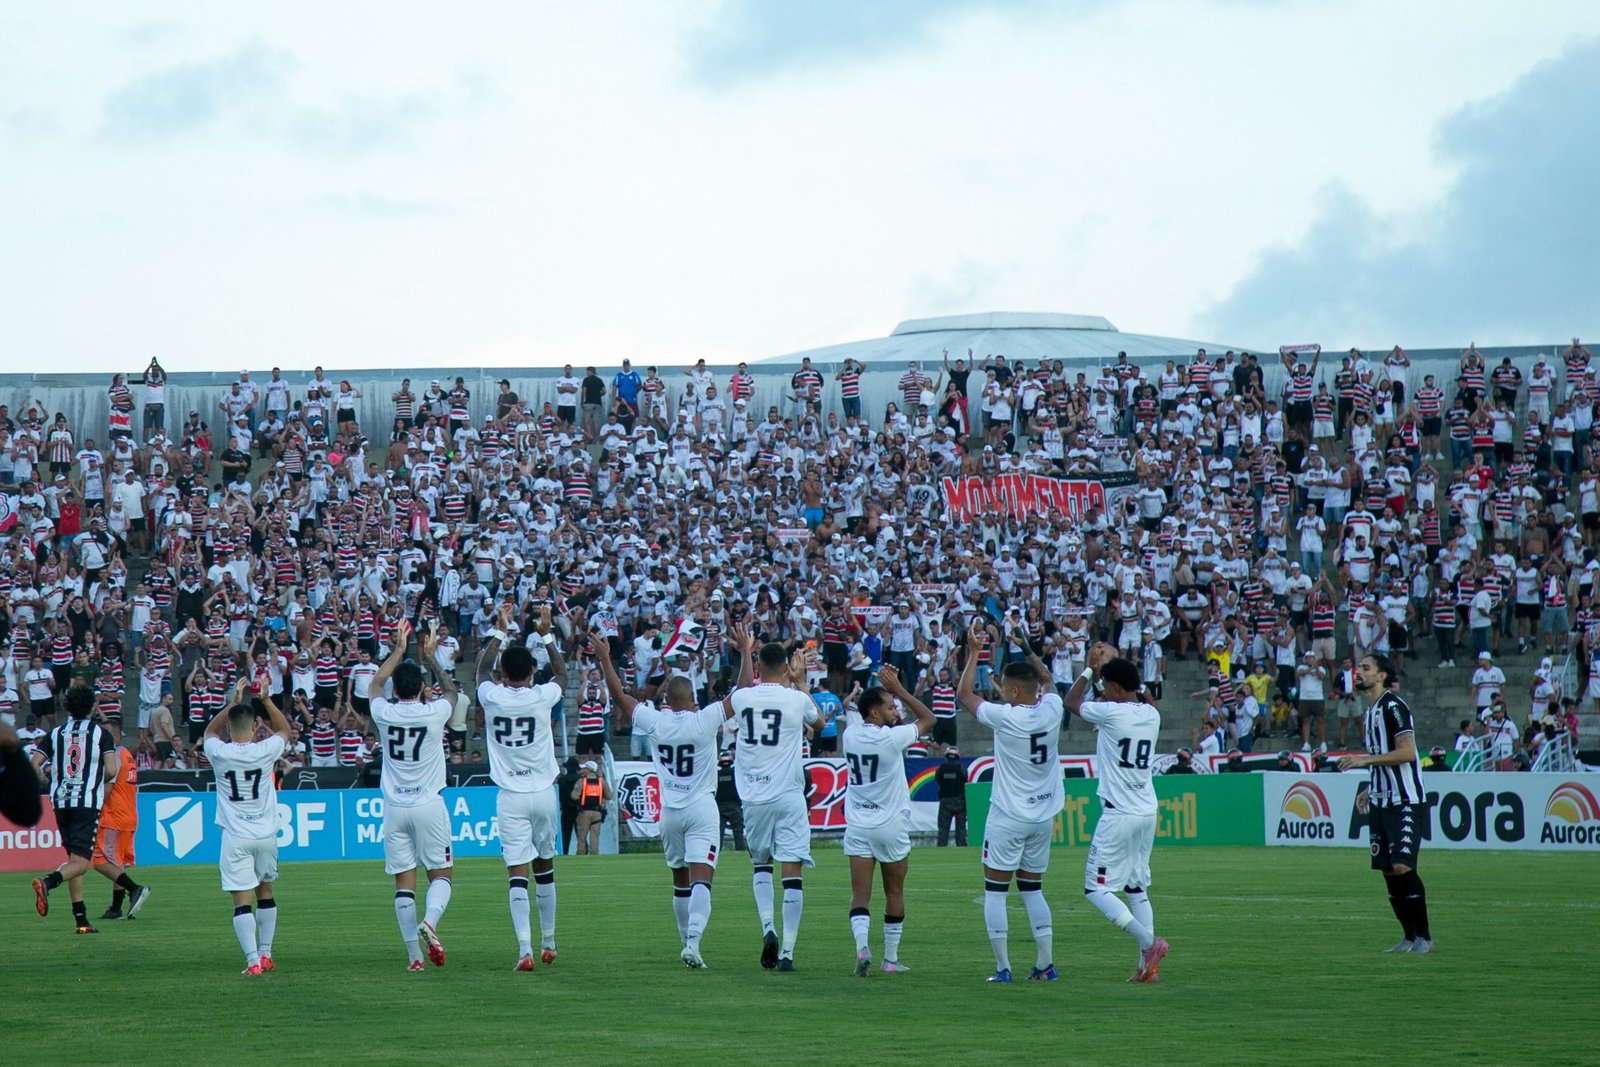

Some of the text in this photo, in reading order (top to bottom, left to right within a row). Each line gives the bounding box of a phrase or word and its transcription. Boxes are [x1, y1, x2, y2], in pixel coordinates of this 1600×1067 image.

[942, 473, 1104, 525] MOVIMENTO
[821, 702, 835, 716] 10
[388, 726, 427, 761] 27
[494, 716, 536, 747] 23
[741, 708, 782, 746] 13
[66, 743, 81, 777] 3
[658, 744, 694, 777] 26
[1030, 732, 1048, 765] 5
[1118, 738, 1151, 769] 18
[224, 769, 262, 801] 17
[846, 752, 879, 785] 37
[1277, 818, 1334, 839] Aurora
[1541, 822, 1600, 843] Aurora
